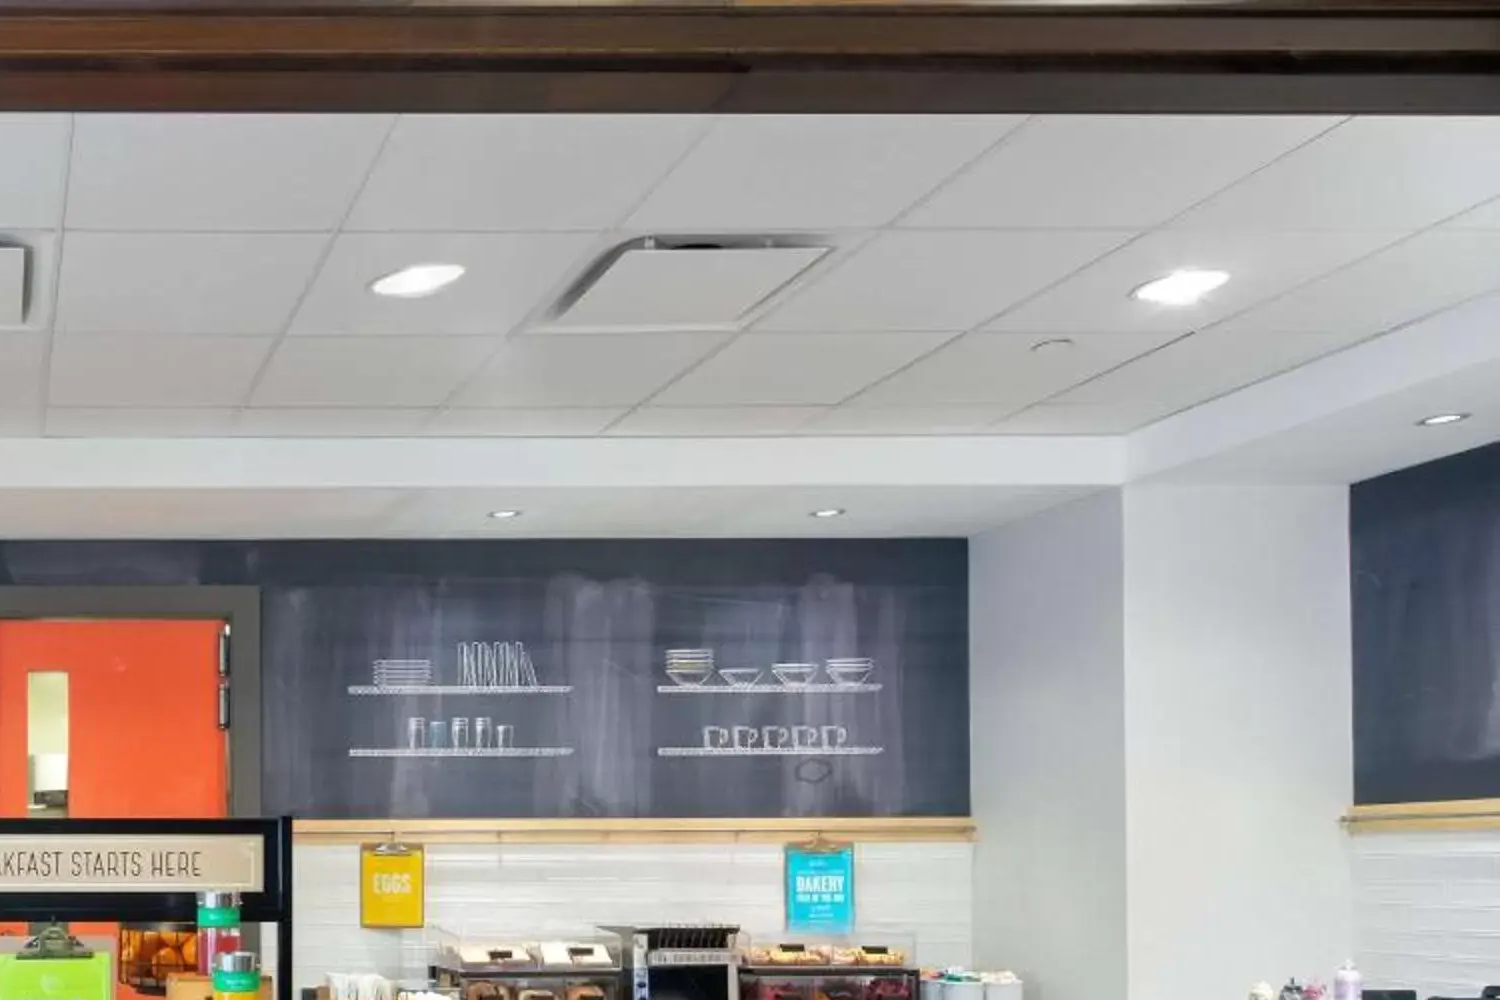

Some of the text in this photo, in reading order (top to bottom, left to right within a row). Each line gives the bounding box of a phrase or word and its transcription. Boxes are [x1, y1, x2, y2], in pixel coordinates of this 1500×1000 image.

[70, 850, 142, 878] STARTS
[151, 850, 203, 878] HERE
[372, 872, 412, 895] EGGS
[795, 875, 845, 893] BAKERY
